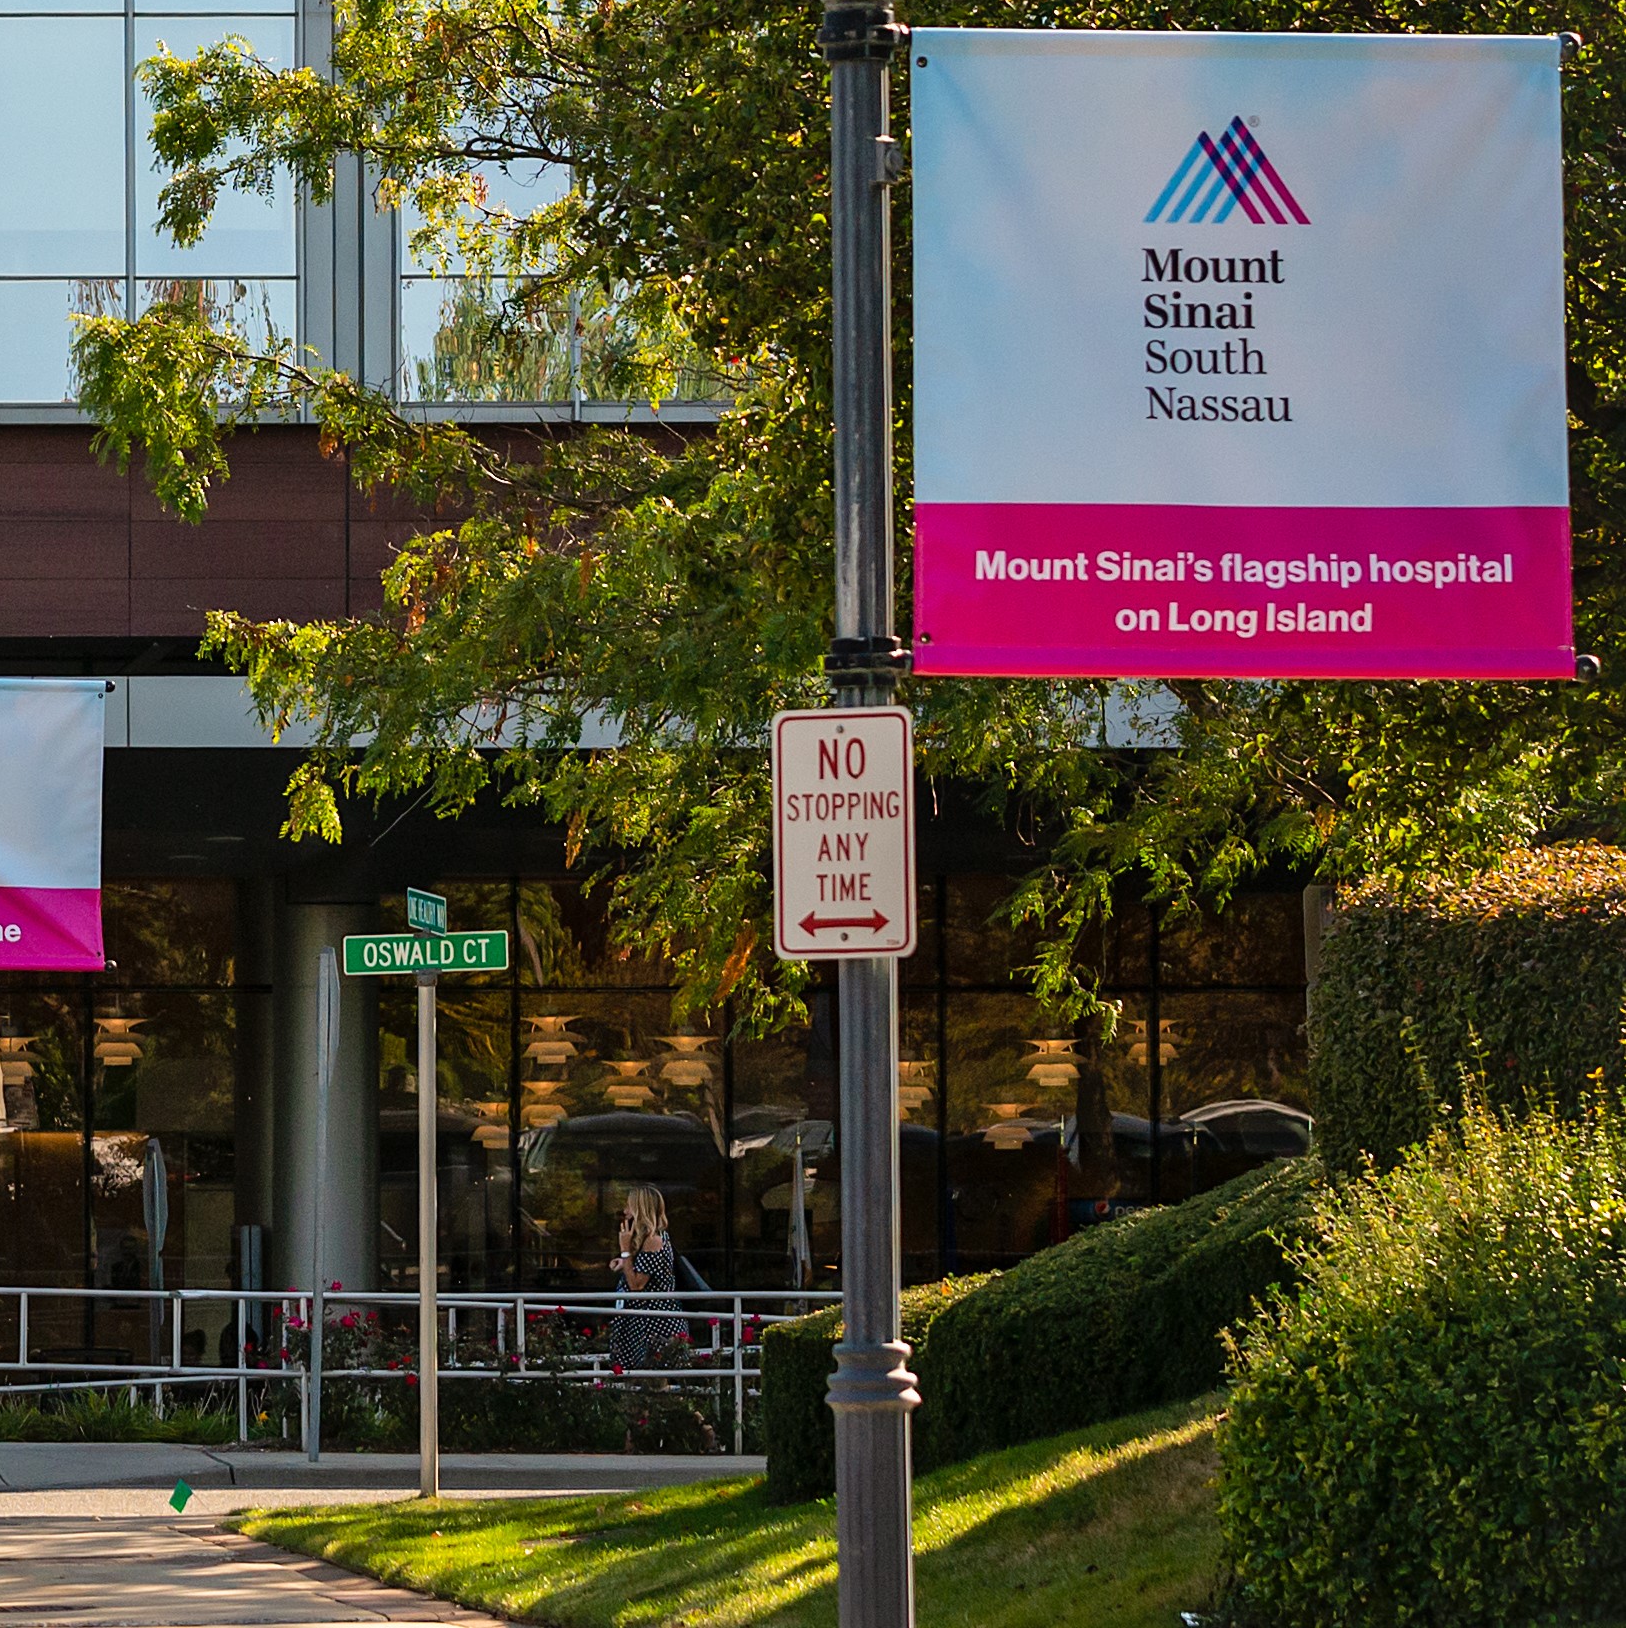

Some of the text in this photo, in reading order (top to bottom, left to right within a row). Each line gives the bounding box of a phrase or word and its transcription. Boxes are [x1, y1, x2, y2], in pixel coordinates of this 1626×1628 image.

[1141, 247, 1285, 285] Mount
[1143, 291, 1256, 331] Sinai
[1145, 338, 1267, 376] South
[1145, 386, 1294, 423] Nassau
[974, 549, 1089, 582] Mount
[1219, 551, 1364, 590] flagship
[1369, 552, 1514, 590] hospital
[1114, 602, 1374, 639] on Long Island
[817, 737, 866, 781] NO
[786, 790, 900, 822] STOPPING
[817, 832, 869, 862] ANY
[816, 872, 872, 902] TIME
[363, 938, 490, 968] OSWALD CT
